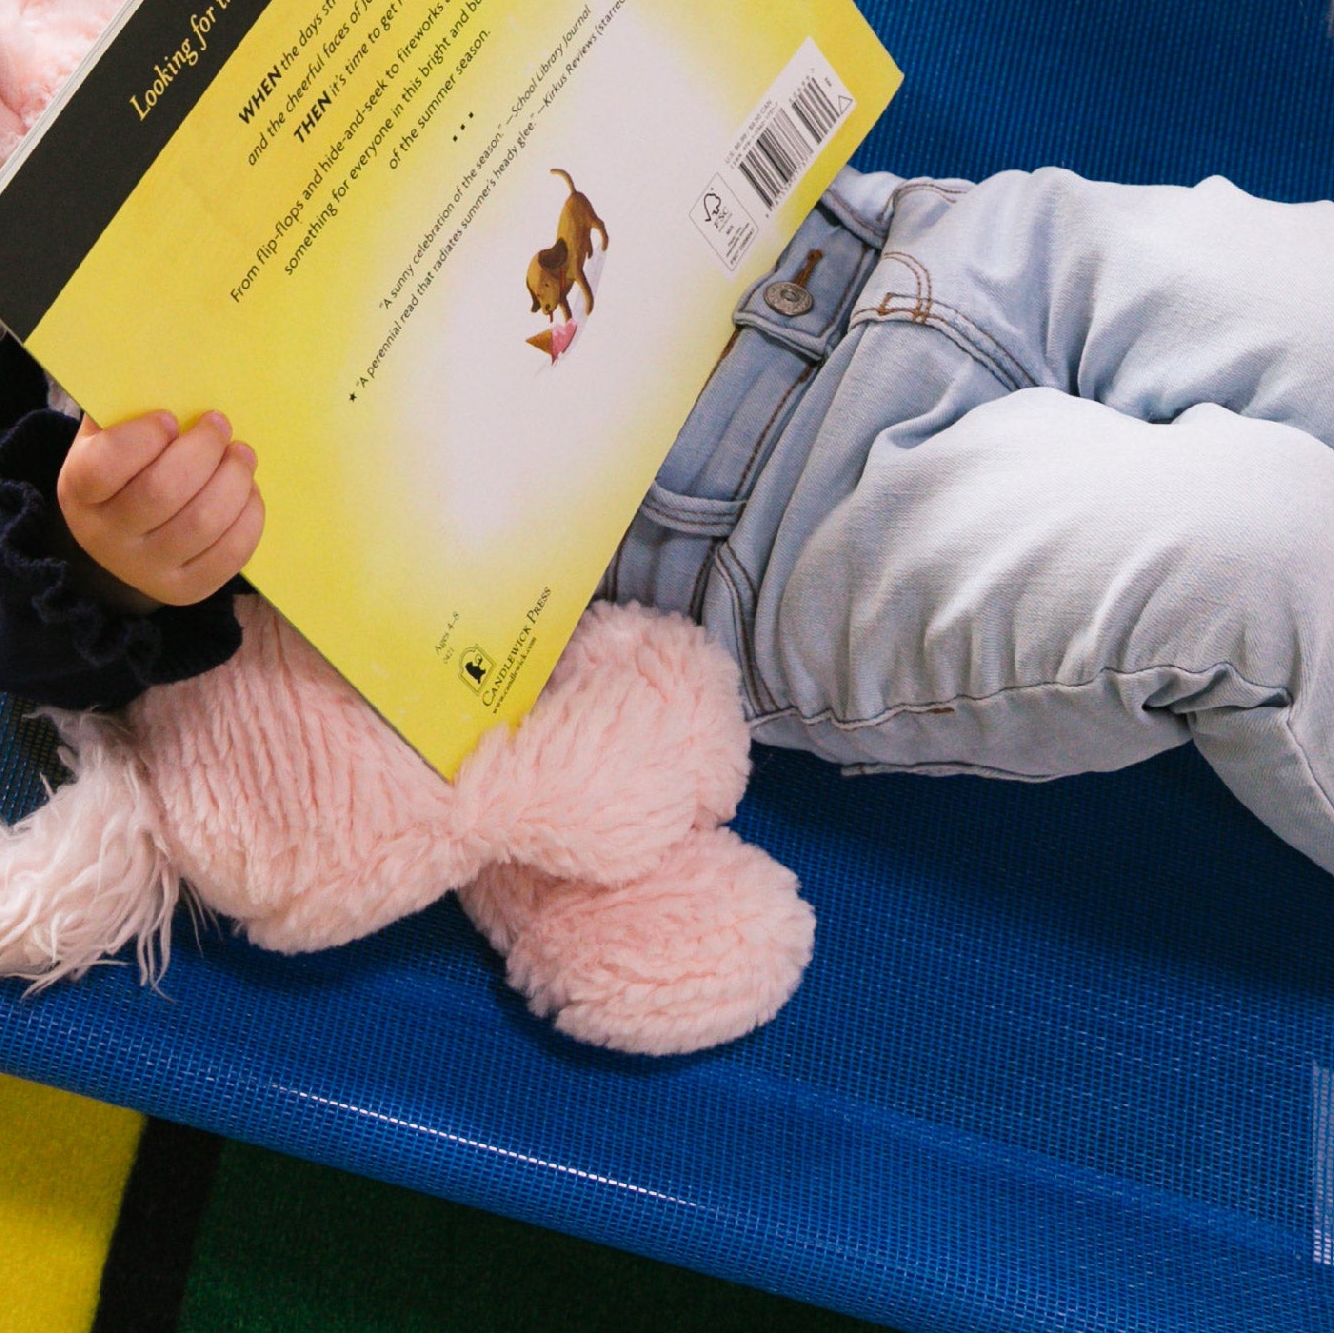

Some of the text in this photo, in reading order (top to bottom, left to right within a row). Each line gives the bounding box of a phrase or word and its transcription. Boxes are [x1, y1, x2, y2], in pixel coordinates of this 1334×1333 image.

[129, 37, 199, 122] Looking
[190, 5, 217, 51] for
[238, 64, 283, 125] WHEN
[280, 45, 300, 71] the
[298, 13, 323, 47] days
[248, 131, 269, 167] and
[266, 111, 286, 138] the
[285, 52, 326, 113] cheerful
[322, 22, 351, 59] faces
[349, 1, 368, 24] of
[293, 89, 333, 144] THEN
[344, 43, 369, 75] time
[367, 27, 381, 44] to
[380, 3, 399, 32] get
[389, 29, 491, 170] of the summer season.
[229, 265, 260, 304] From
[256, 200, 304, 266] flip-flops
[301, 168, 324, 201] and
[317, 79, 389, 173] hide-and-seek
[385, 63, 399, 80] to
[397, 2, 444, 64] fireworks
[284, 202, 339, 276] something
[331, 179, 350, 204] for
[349, 117, 394, 180] everyone
[390, 103, 405, 119] in
[401, 76, 423, 103] this
[417, 37, 452, 78] bright
[449, 8, 470, 39] and
[366, 320, 402, 380] perennial
[399, 293, 419, 324] read
[416, 271, 435, 296] that
[432, 228, 463, 273] radiates
[492, 145, 518, 180] heady
[565, 33, 597, 76] Reviews
[390, 263, 415, 299] sunny
[413, 203, 455, 265] celebration
[453, 185, 463, 203] of
[461, 168, 478, 189] the
[535, 43, 564, 83] Library
[562, 4, 592, 49] Journal
[482, 586, 551, 708] CANDLEWICK PRESS
